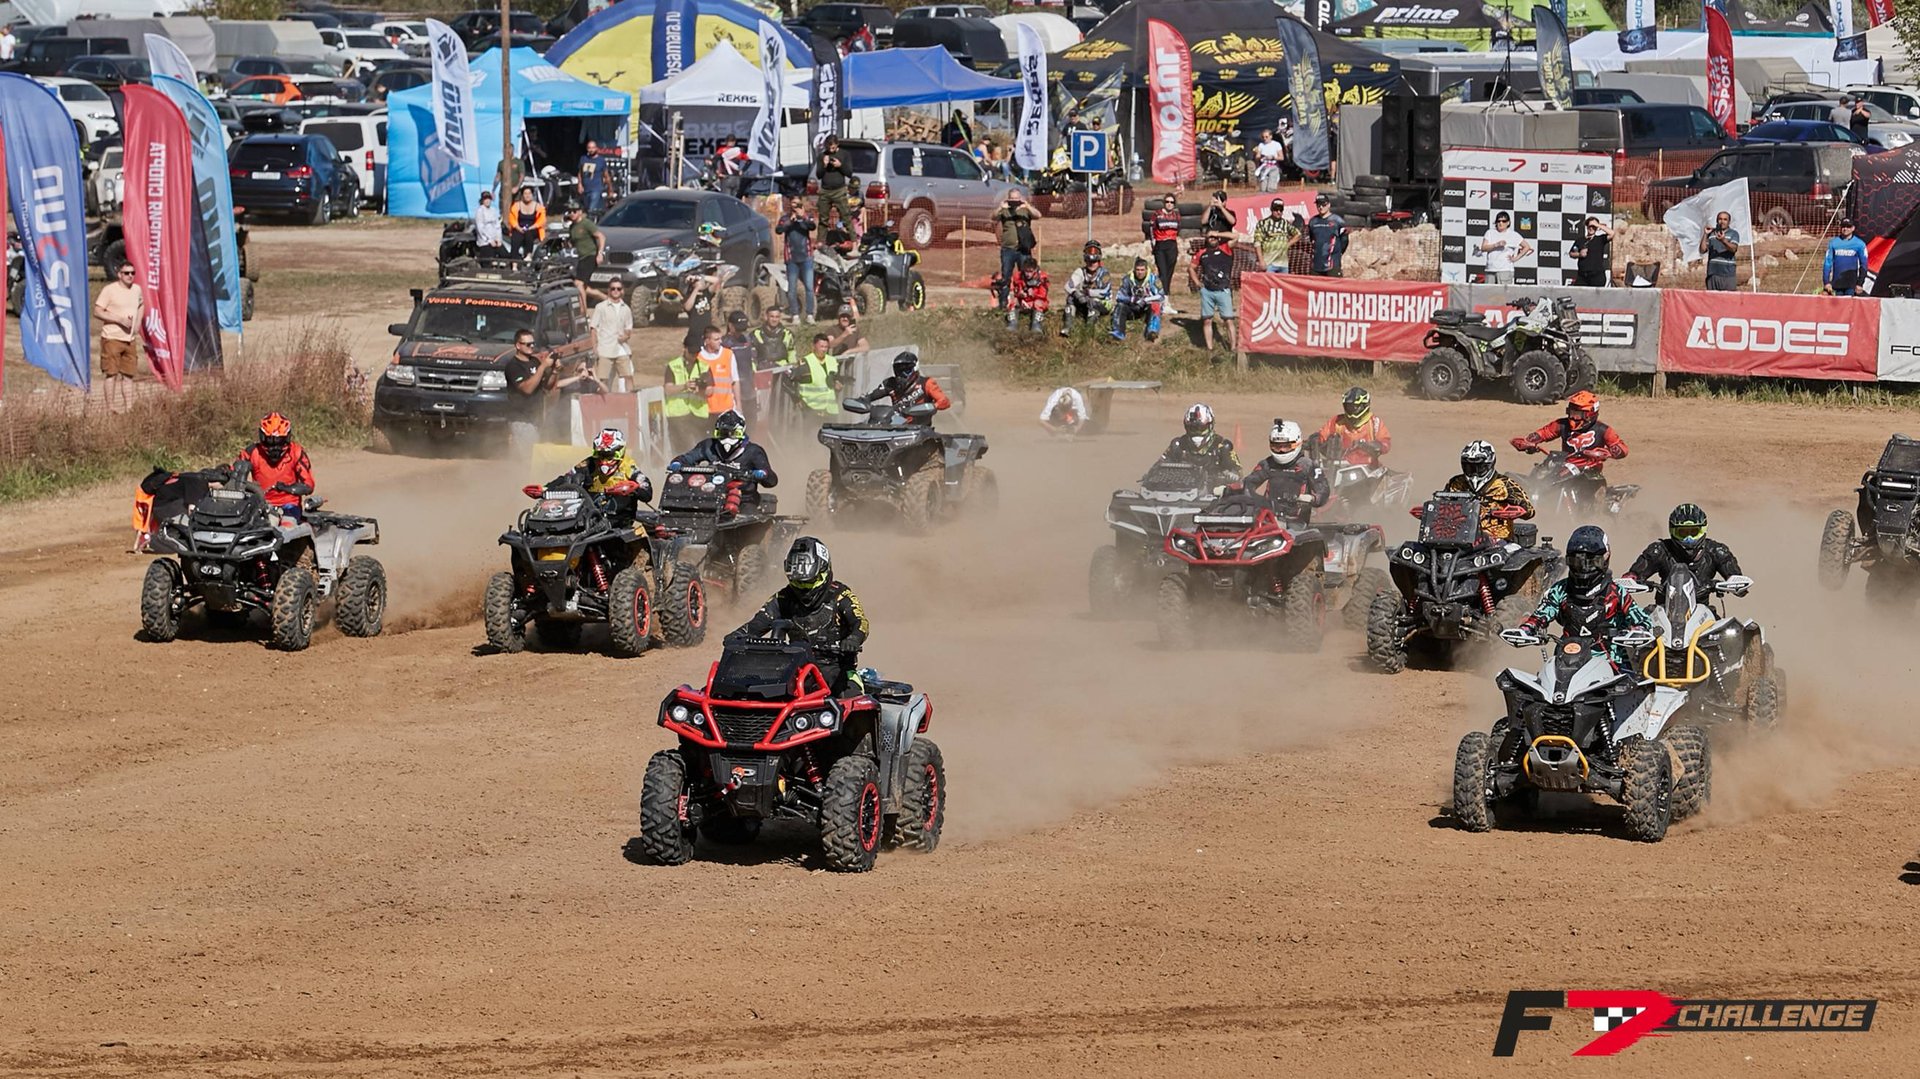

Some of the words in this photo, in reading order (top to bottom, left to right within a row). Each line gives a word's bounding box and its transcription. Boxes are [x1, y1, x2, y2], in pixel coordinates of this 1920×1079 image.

[1373, 4, 1459, 22] prime
[717, 92, 758, 104] REXAS
[1713, 55, 1732, 118] SPORT
[441, 79, 464, 160] YOKO
[813, 63, 834, 149] REXAS
[1079, 135, 1100, 167] P
[1508, 158, 1526, 173] 7
[1469, 190, 1487, 198] F7
[428, 297, 462, 305] Vostok
[465, 298, 538, 311] Podmoskov'ya
[1307, 290, 1443, 323] МОСКОВСКИЙ
[1306, 319, 1371, 350] СПОРТ
[1484, 308, 1637, 348] AES
[1685, 315, 1850, 357] AODES
[790, 563, 813, 576] FLY
